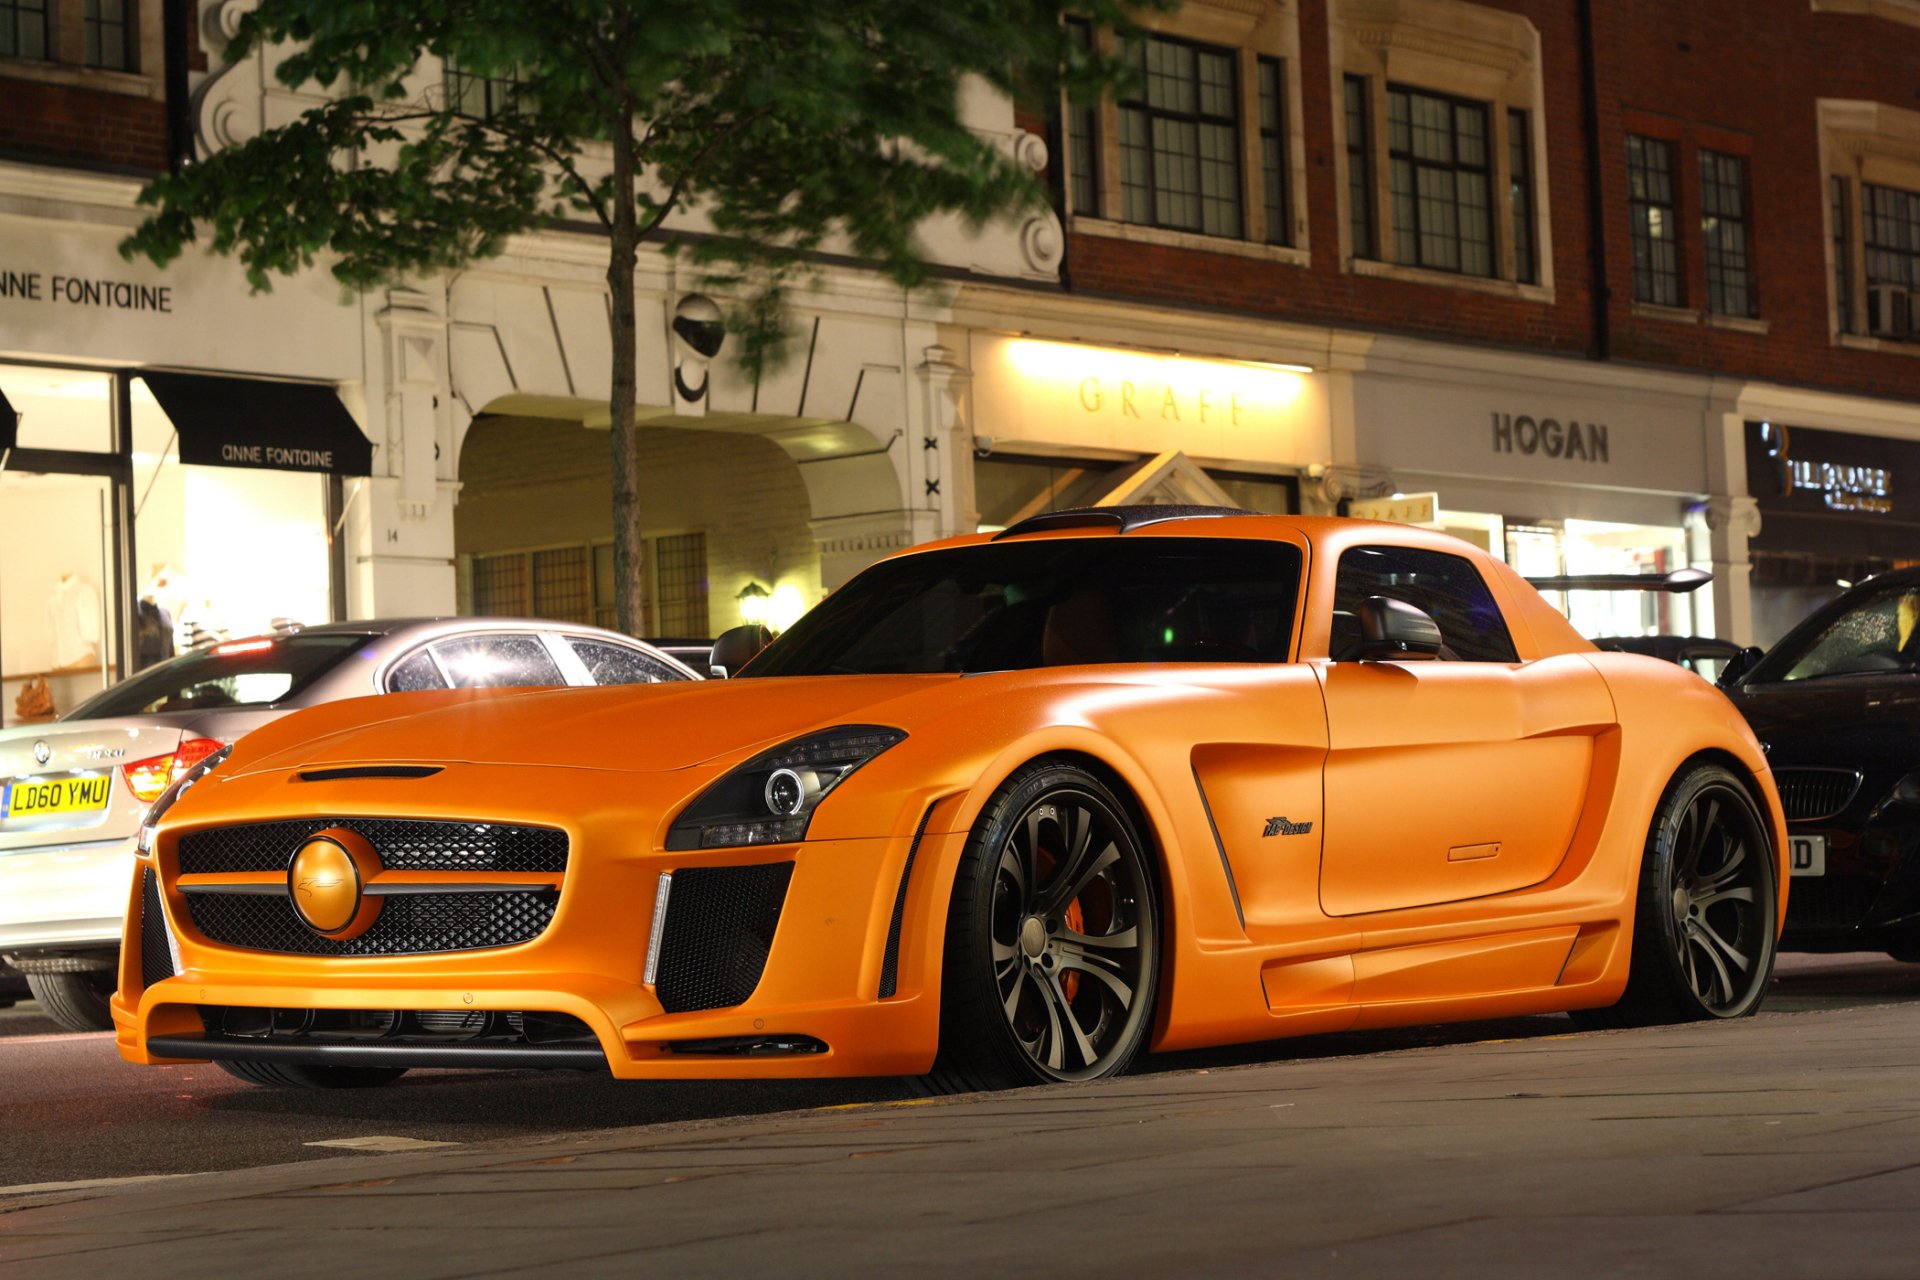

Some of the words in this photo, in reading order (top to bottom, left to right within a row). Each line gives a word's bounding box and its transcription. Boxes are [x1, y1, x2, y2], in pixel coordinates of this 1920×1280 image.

[1079, 376, 1244, 426] GRAFF
[1491, 411, 1609, 463] HOGAN
[14, 784, 62, 811] LD60
[69, 780, 105, 806] YMU
[1789, 839, 1812, 869] D
